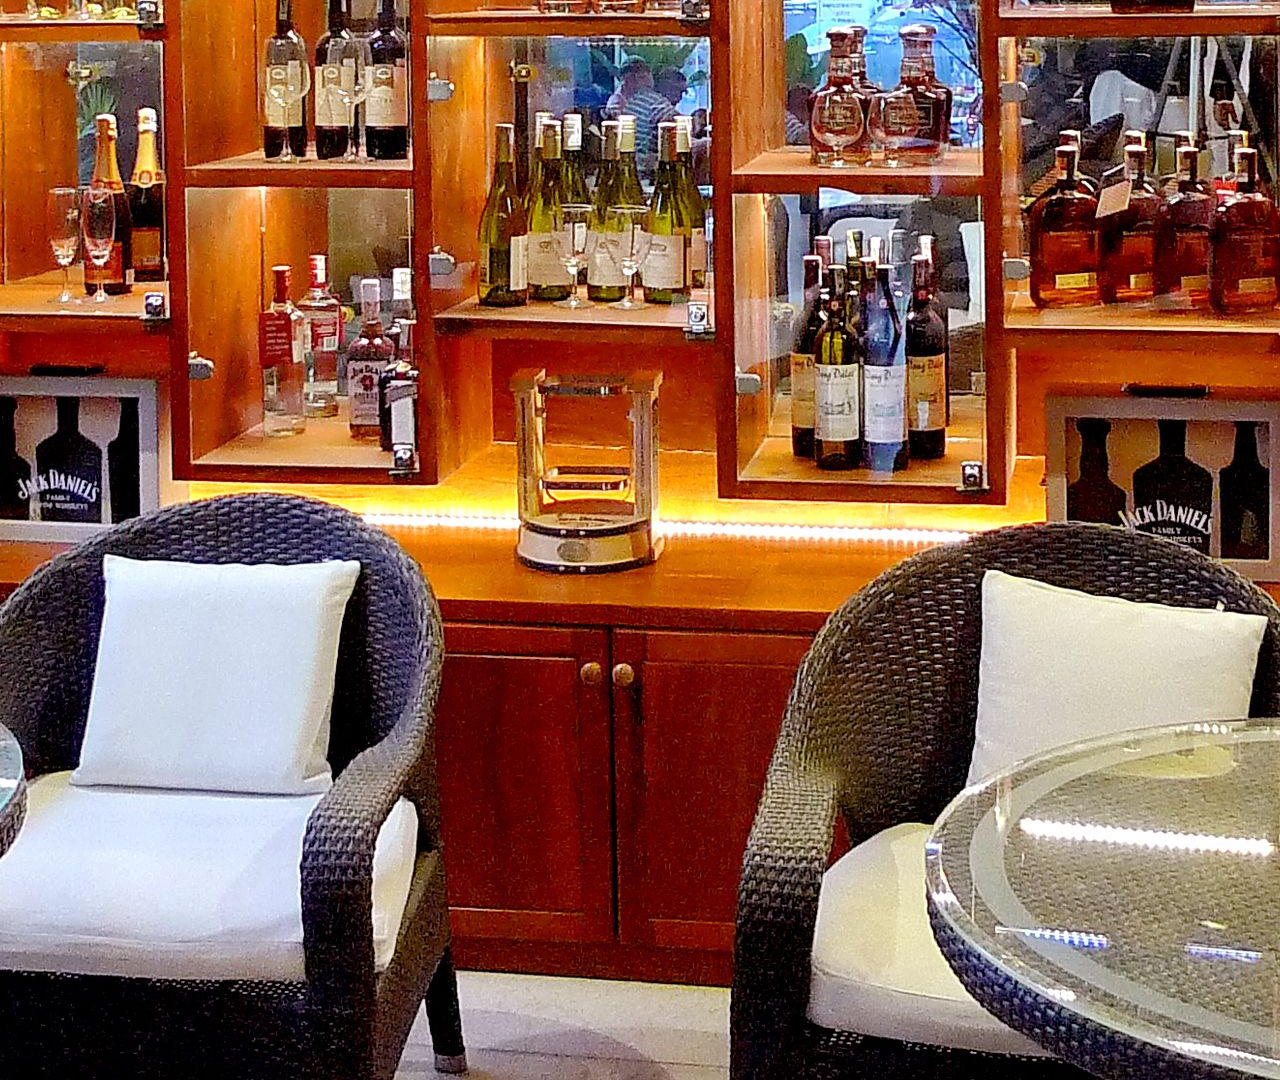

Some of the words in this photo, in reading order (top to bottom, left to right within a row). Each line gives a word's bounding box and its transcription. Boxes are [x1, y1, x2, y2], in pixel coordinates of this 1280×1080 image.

[366, 364, 380, 374] BEA
[17, 473, 49, 500] JACK
[49, 469, 100, 502] DANIEL'S
[1117, 504, 1156, 528] JACK
